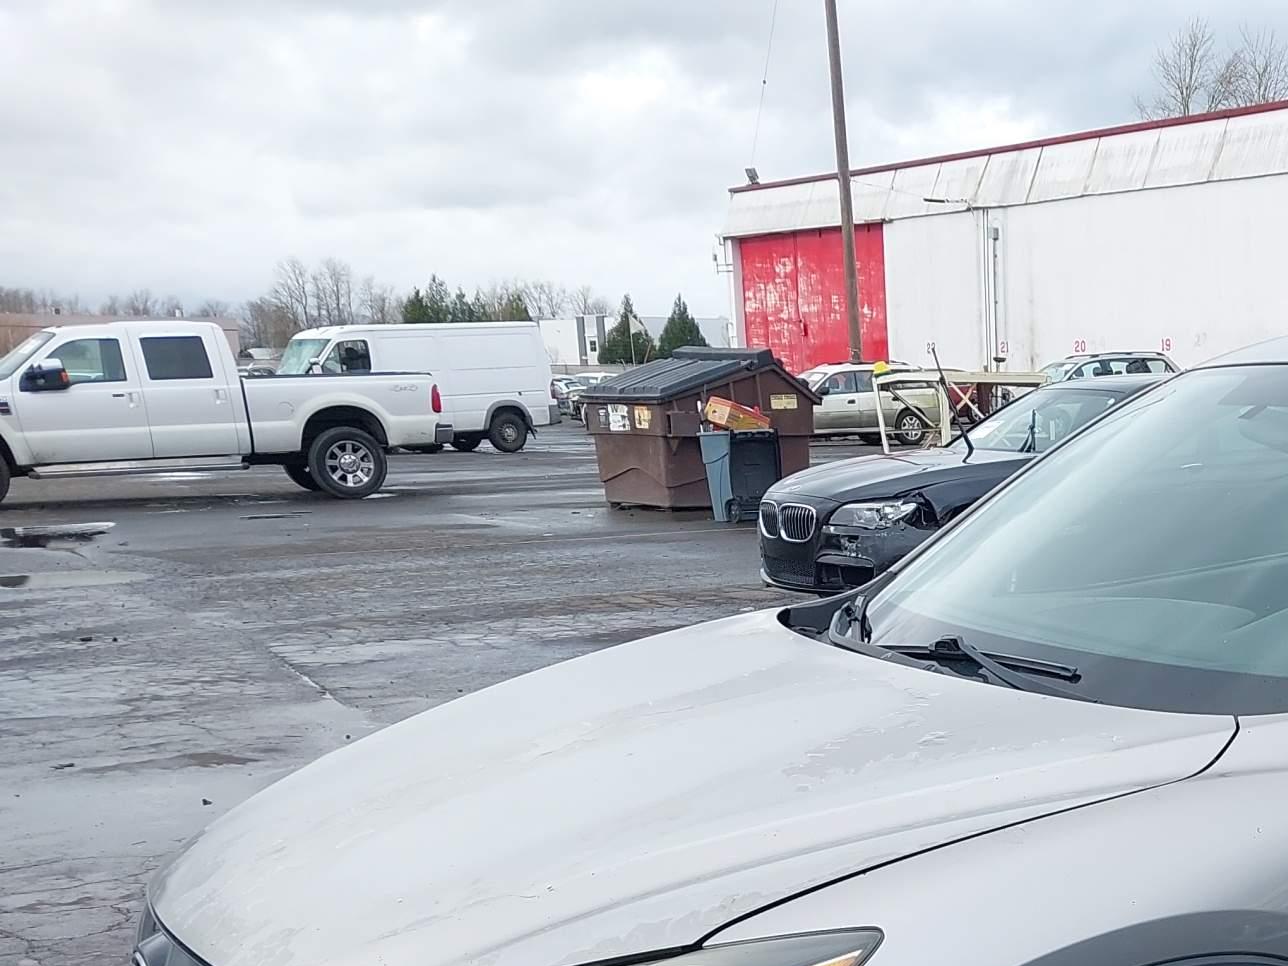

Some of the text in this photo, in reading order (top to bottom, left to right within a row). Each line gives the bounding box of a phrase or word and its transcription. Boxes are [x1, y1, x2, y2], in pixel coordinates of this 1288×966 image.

[1000, 341, 1009, 353] 21
[1074, 340, 1086, 353] 20
[1161, 338, 1171, 351] 19
